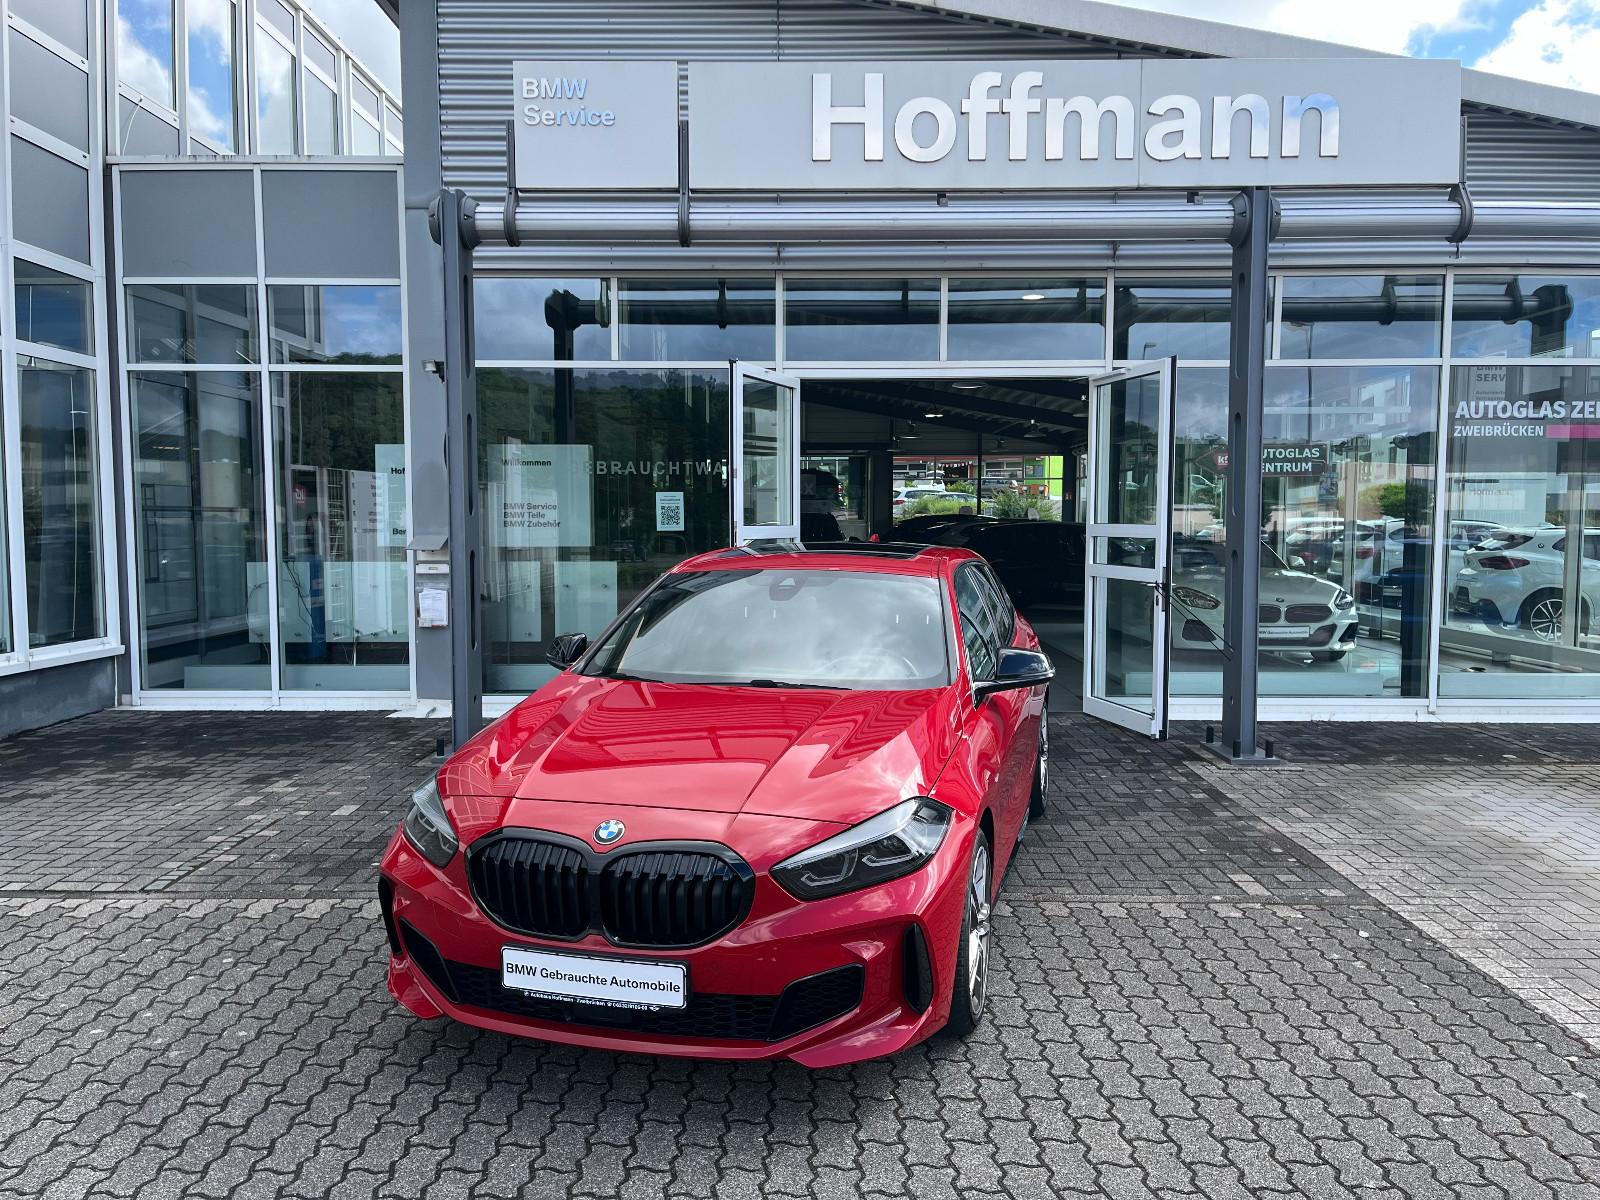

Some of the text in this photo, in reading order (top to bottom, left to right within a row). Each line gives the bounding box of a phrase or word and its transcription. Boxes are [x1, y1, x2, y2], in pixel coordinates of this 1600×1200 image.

[522, 77, 588, 99] BMW
[523, 104, 616, 126] Service
[811, 71, 1340, 162] Hoffmann
[1455, 400, 1567, 419] AUTOGLAS
[1454, 422, 1544, 437] ZWEIBRÜCKEN
[503, 519, 561, 528] BMW Zubehör
[527, 511, 545, 519] Teile
[506, 962, 681, 993] BMW Gebrauchte Automobile
